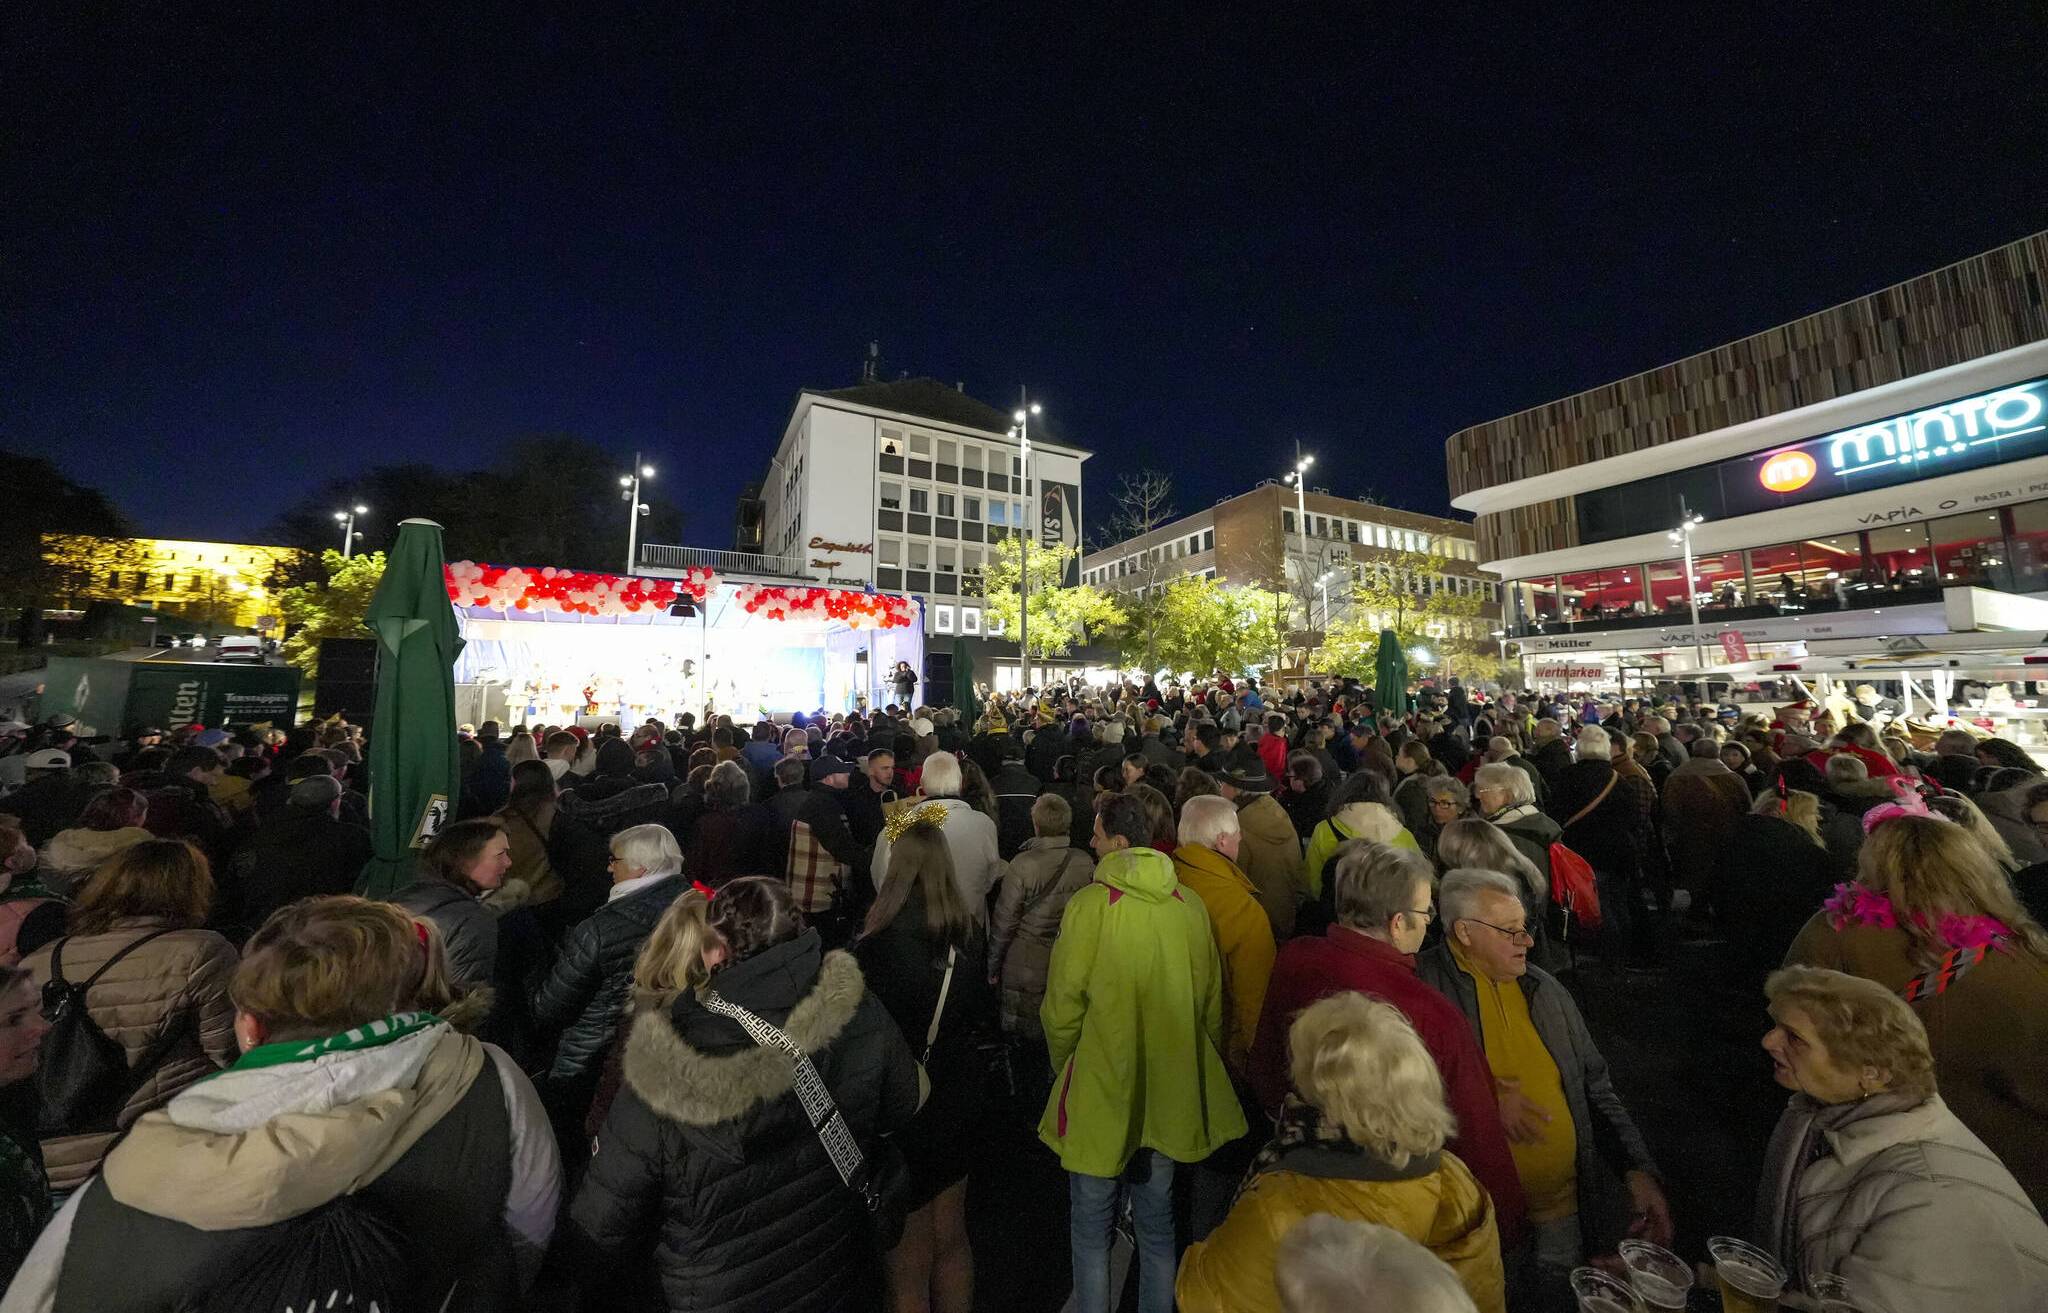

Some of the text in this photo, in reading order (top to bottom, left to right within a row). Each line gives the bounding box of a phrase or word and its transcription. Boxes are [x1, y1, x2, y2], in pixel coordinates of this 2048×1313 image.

[1974, 489, 2012, 503] PASTA
[1548, 640, 1592, 649] Müller
[1535, 665, 1602, 678] Wertmarken
